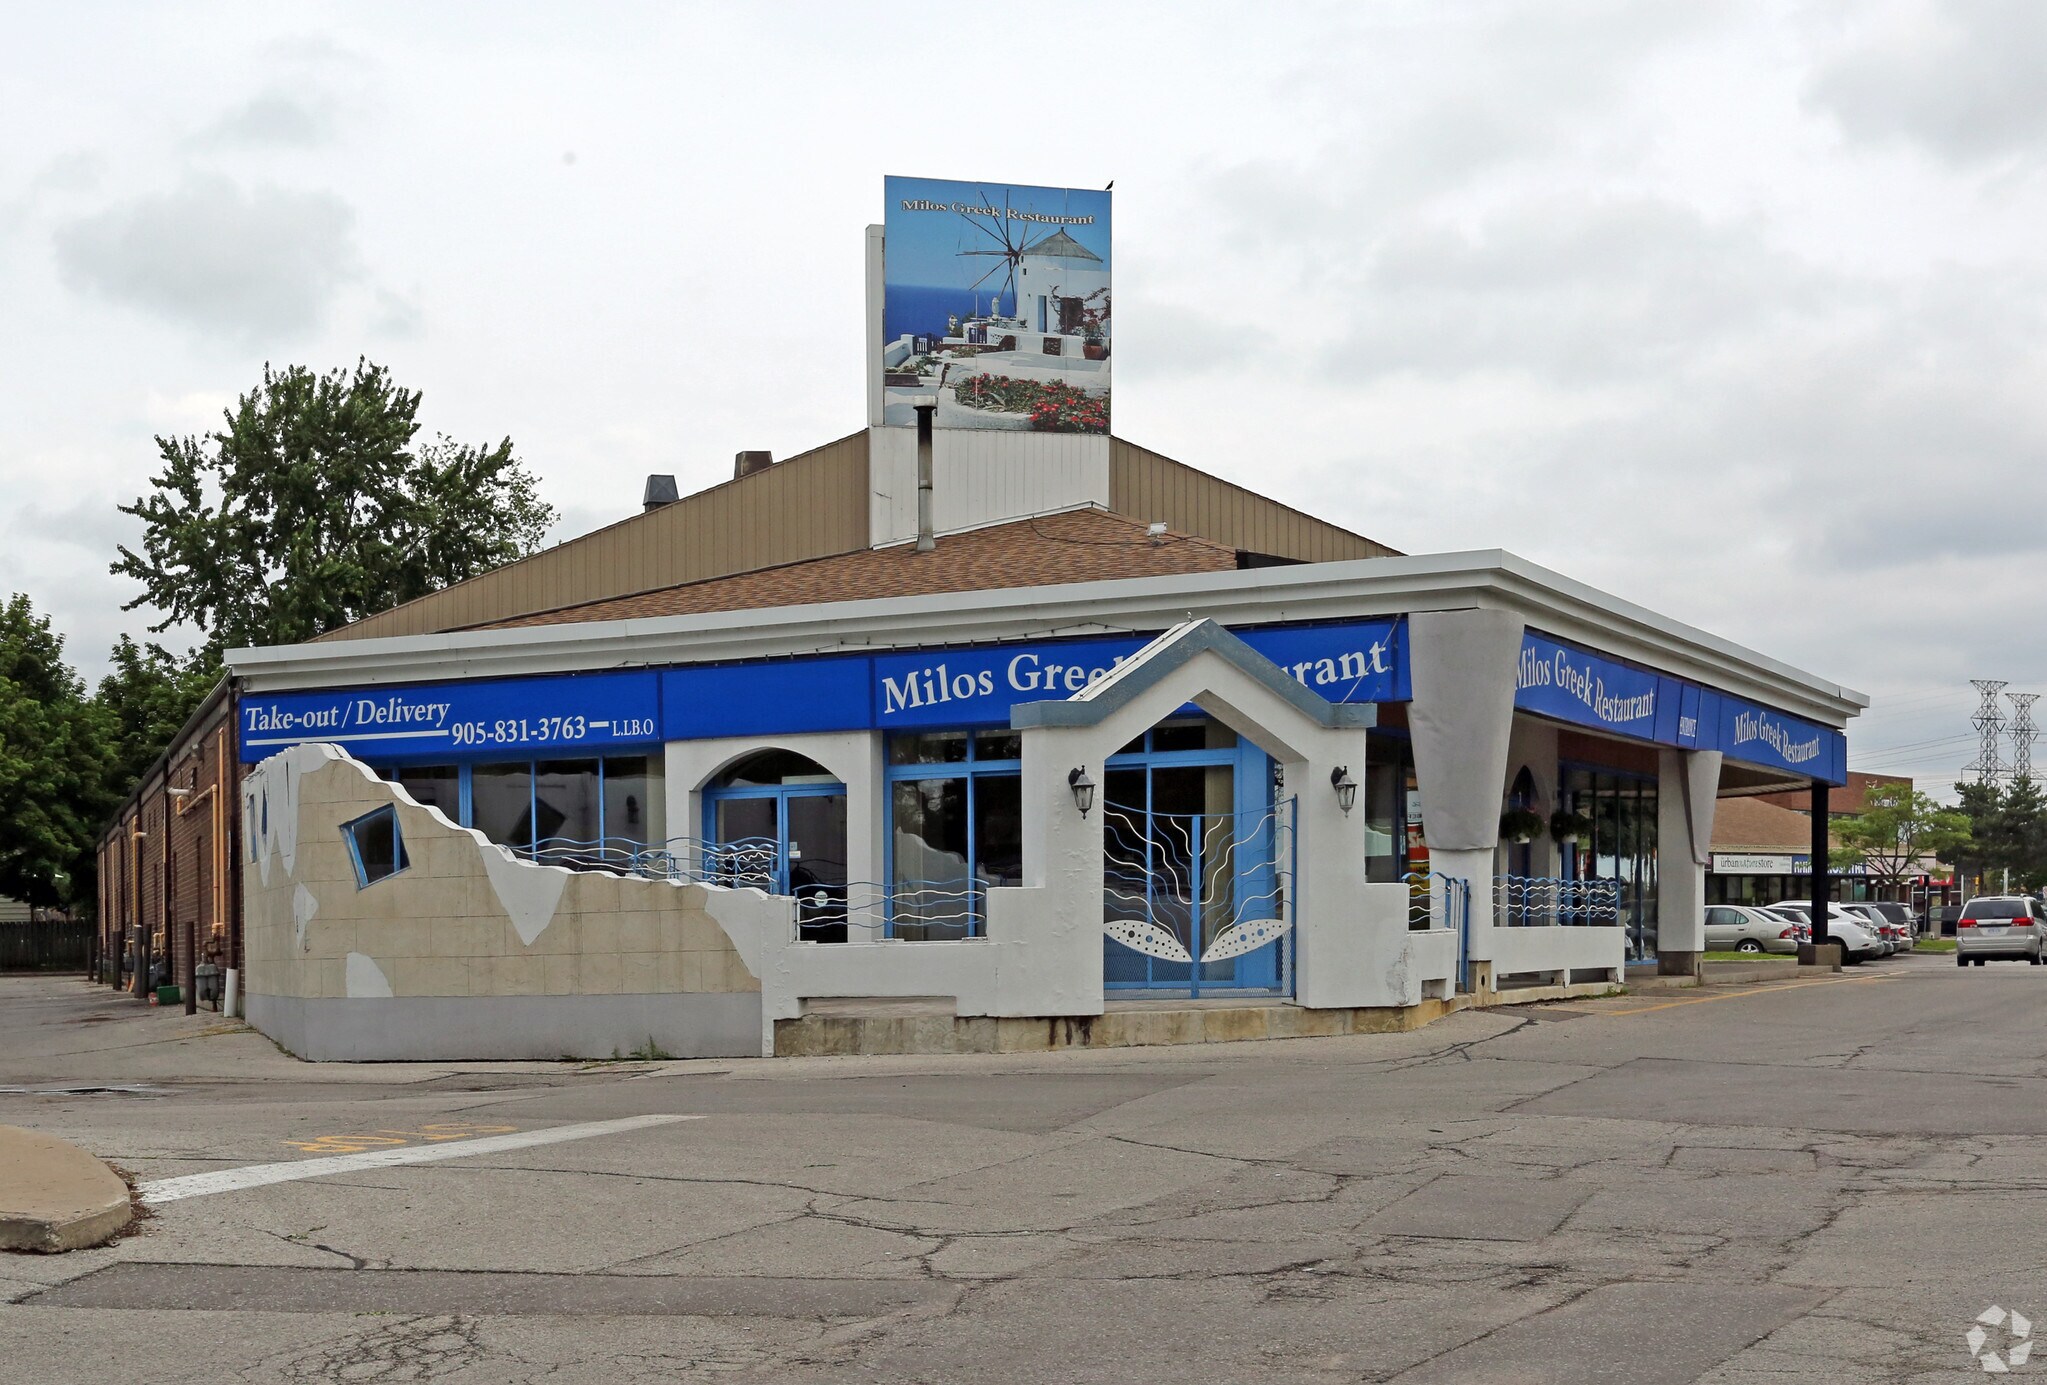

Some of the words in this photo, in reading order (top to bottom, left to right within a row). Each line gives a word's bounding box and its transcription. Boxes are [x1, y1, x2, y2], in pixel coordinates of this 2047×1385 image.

[901, 199, 947, 211] Milos
[951, 202, 1001, 217] Greek
[1006, 208, 1095, 225] Restaurant
[882, 663, 994, 714] Milos
[1007, 653, 1124, 691] Gree
[1515, 646, 1550, 690] Milos
[1554, 649, 1593, 707] Greek
[1593, 677, 1655, 722] Restaurant
[245, 704, 339, 732] Take-out
[355, 697, 450, 728] Delivery
[452, 715, 586, 746] 905-831-3763
[1734, 711, 1758, 745] Milos
[1759, 711, 1781, 752] Greek
[1782, 730, 1820, 764] Restaurant
